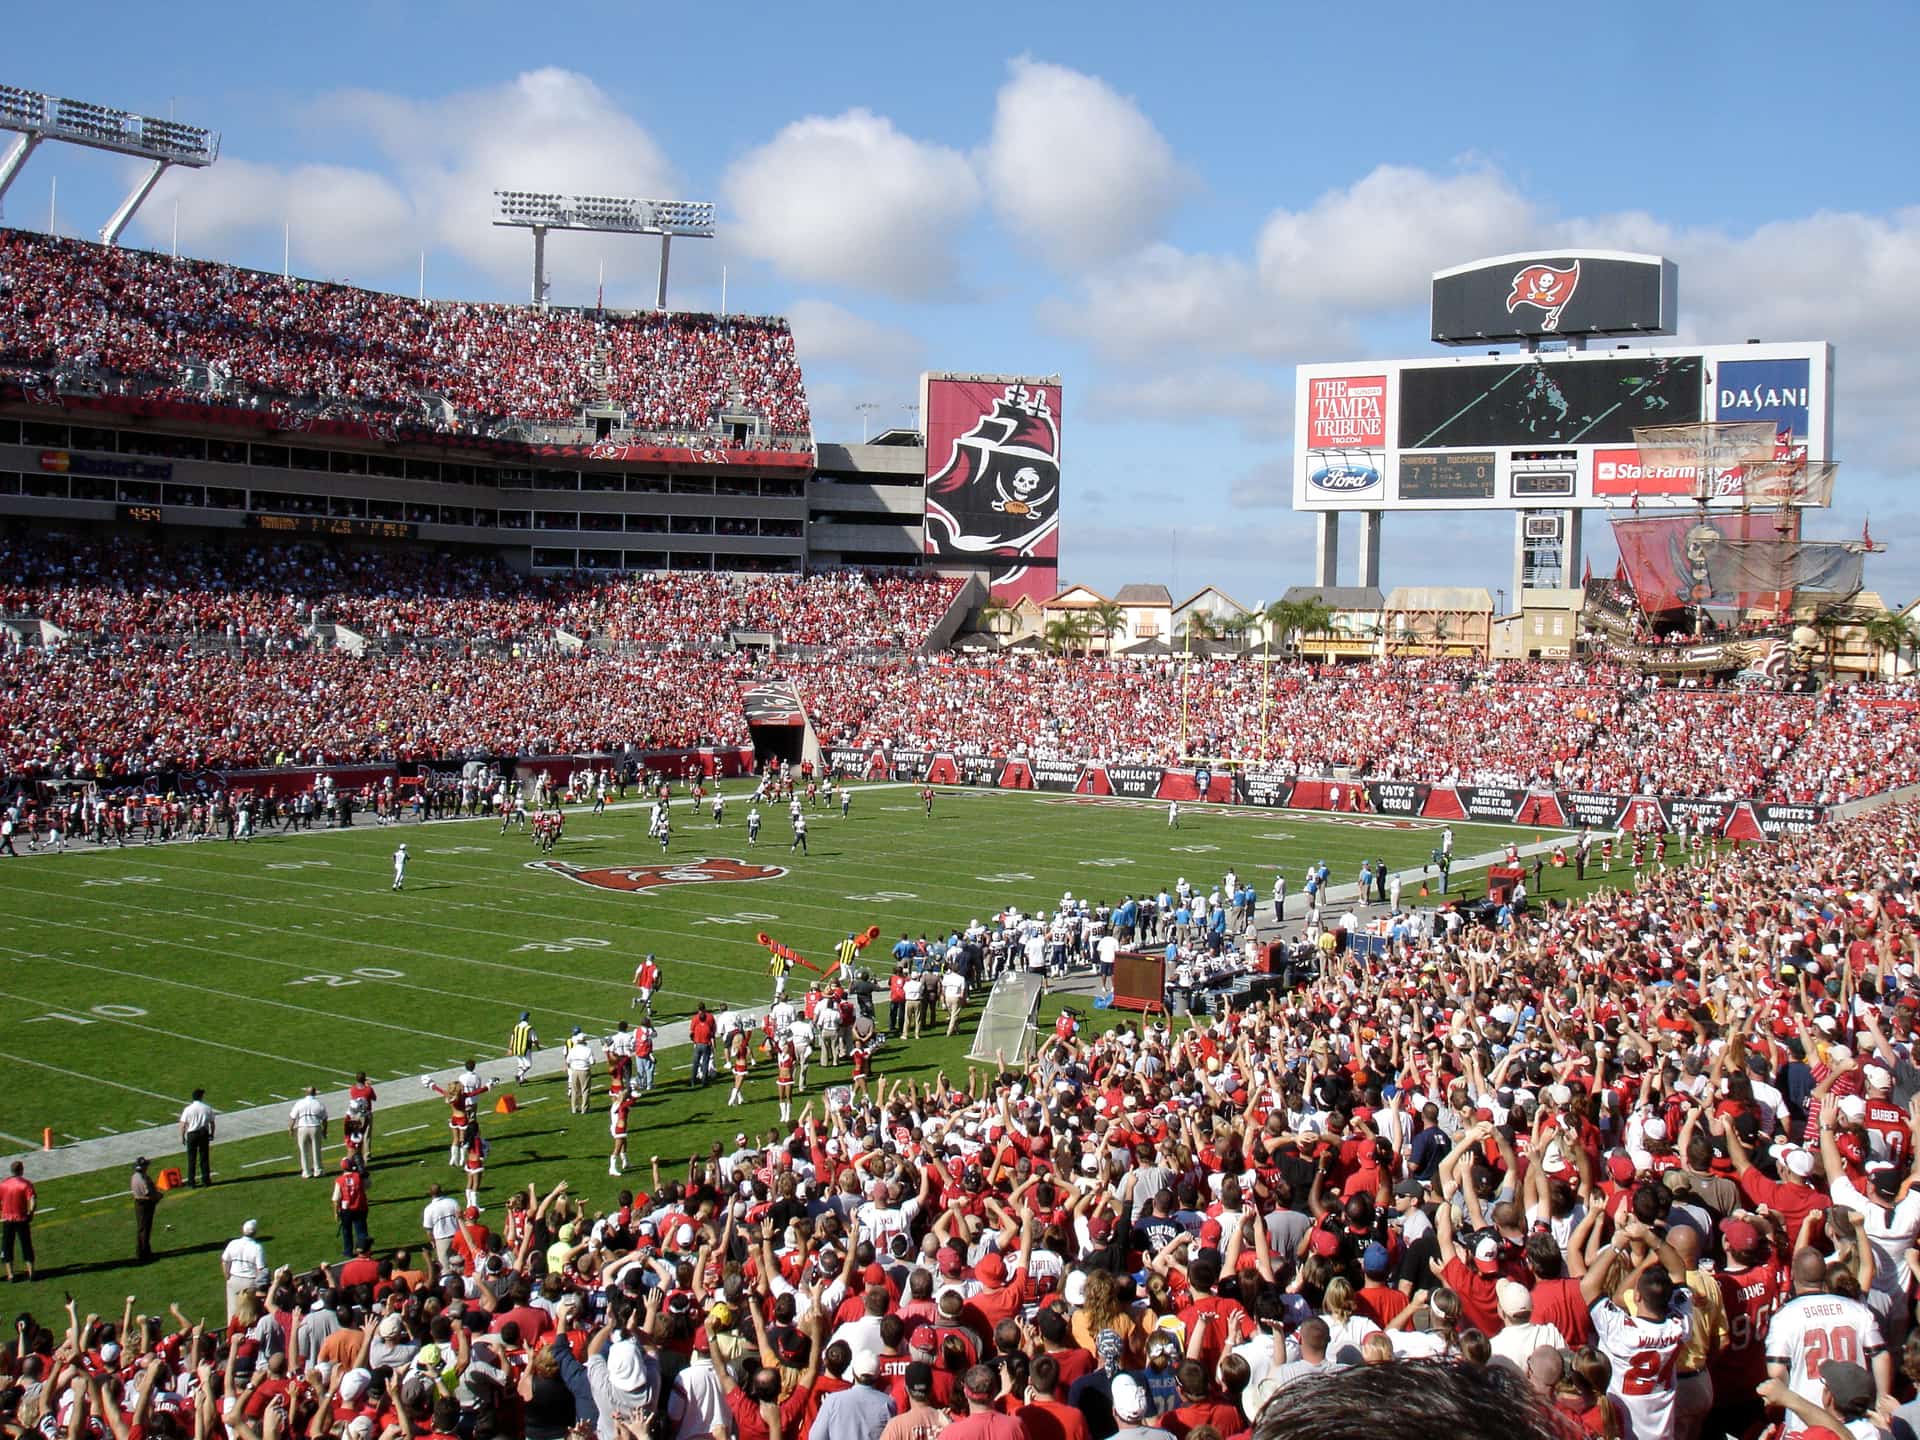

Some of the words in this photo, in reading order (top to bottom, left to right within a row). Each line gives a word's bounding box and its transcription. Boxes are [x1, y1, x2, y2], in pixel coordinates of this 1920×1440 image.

[1315, 381, 1347, 398] THE
[1721, 385, 1807, 411] DASANI
[1314, 397, 1381, 419] TAMPA
[1314, 419, 1382, 436] TRIBUNE
[1322, 470, 1367, 489] Ford
[1109, 769, 1161, 781] CADILLAC'S
[1123, 781, 1146, 792] KIDS
[1379, 784, 1416, 797] CATO'S
[1382, 798, 1412, 810] CREW
[1767, 807, 1815, 820] WHITE'S
[1871, 1108, 1900, 1123] BARBER
[1803, 1303, 1844, 1319] BARBER
[1803, 1325, 1858, 1380] 20
